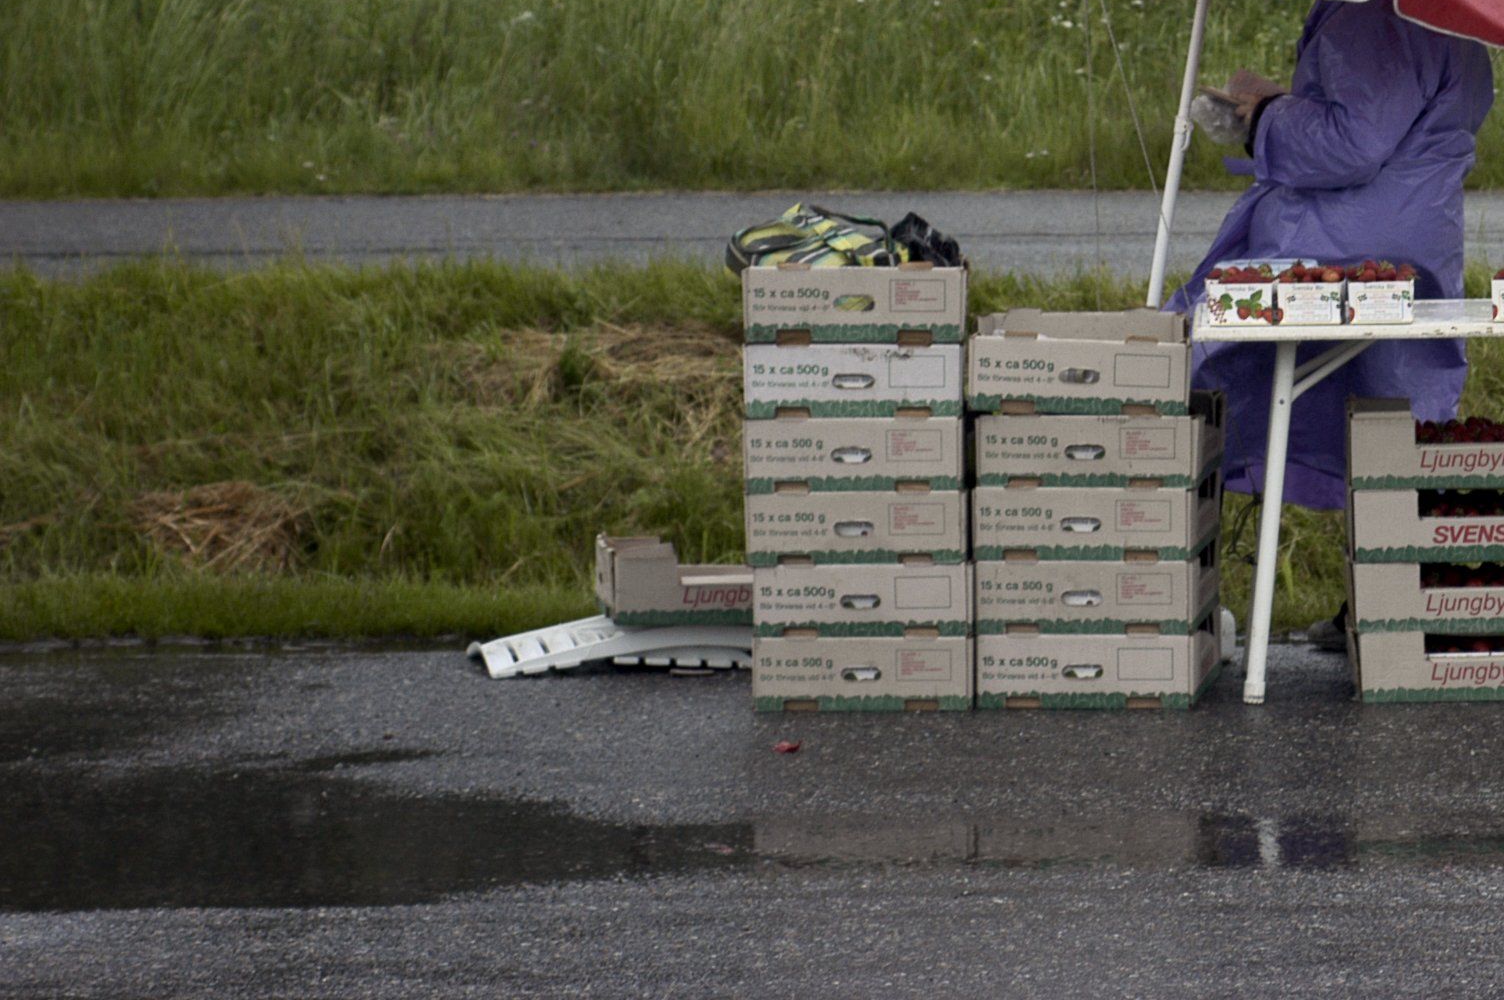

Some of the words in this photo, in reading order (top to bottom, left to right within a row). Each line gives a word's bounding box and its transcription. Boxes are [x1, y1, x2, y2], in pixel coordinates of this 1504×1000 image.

[754, 287, 765, 298] 15
[780, 290, 794, 298] ca
[797, 288, 820, 298] 500
[822, 290, 829, 300] g
[753, 364, 765, 374] 15
[797, 365, 819, 374] 500
[821, 367, 828, 376] g
[978, 358, 990, 368] 15
[1006, 360, 1019, 369] ca
[1023, 359, 1045, 370] 500
[1047, 362, 1054, 372] g
[751, 439, 762, 448] 15
[776, 440, 788, 448] ca
[792, 439, 812, 448] 500
[816, 440, 823, 450] g
[986, 435, 997, 444] 15
[1027, 436, 1047, 445] 500
[1051, 438, 1058, 447] g
[753, 513, 764, 522] 15
[795, 512, 814, 522] 500
[818, 514, 825, 524] g
[980, 506, 991, 516] 15
[1022, 508, 1041, 517] 500
[1045, 509, 1053, 519] g
[760, 586, 772, 597] 15
[787, 589, 801, 597] ca
[804, 587, 826, 597] 500
[828, 589, 835, 599] g
[981, 581, 992, 590] 15
[1022, 581, 1042, 590] 500
[1046, 583, 1053, 592] g
[683, 586, 753, 608] Ljungb
[760, 657, 772, 667] 15
[785, 659, 798, 667] ca
[802, 658, 822, 667] 500
[826, 659, 833, 669] g
[982, 656, 994, 666] 15
[1009, 658, 1023, 666] ca
[1026, 657, 1048, 667] 500
[1050, 659, 1058, 668] g
